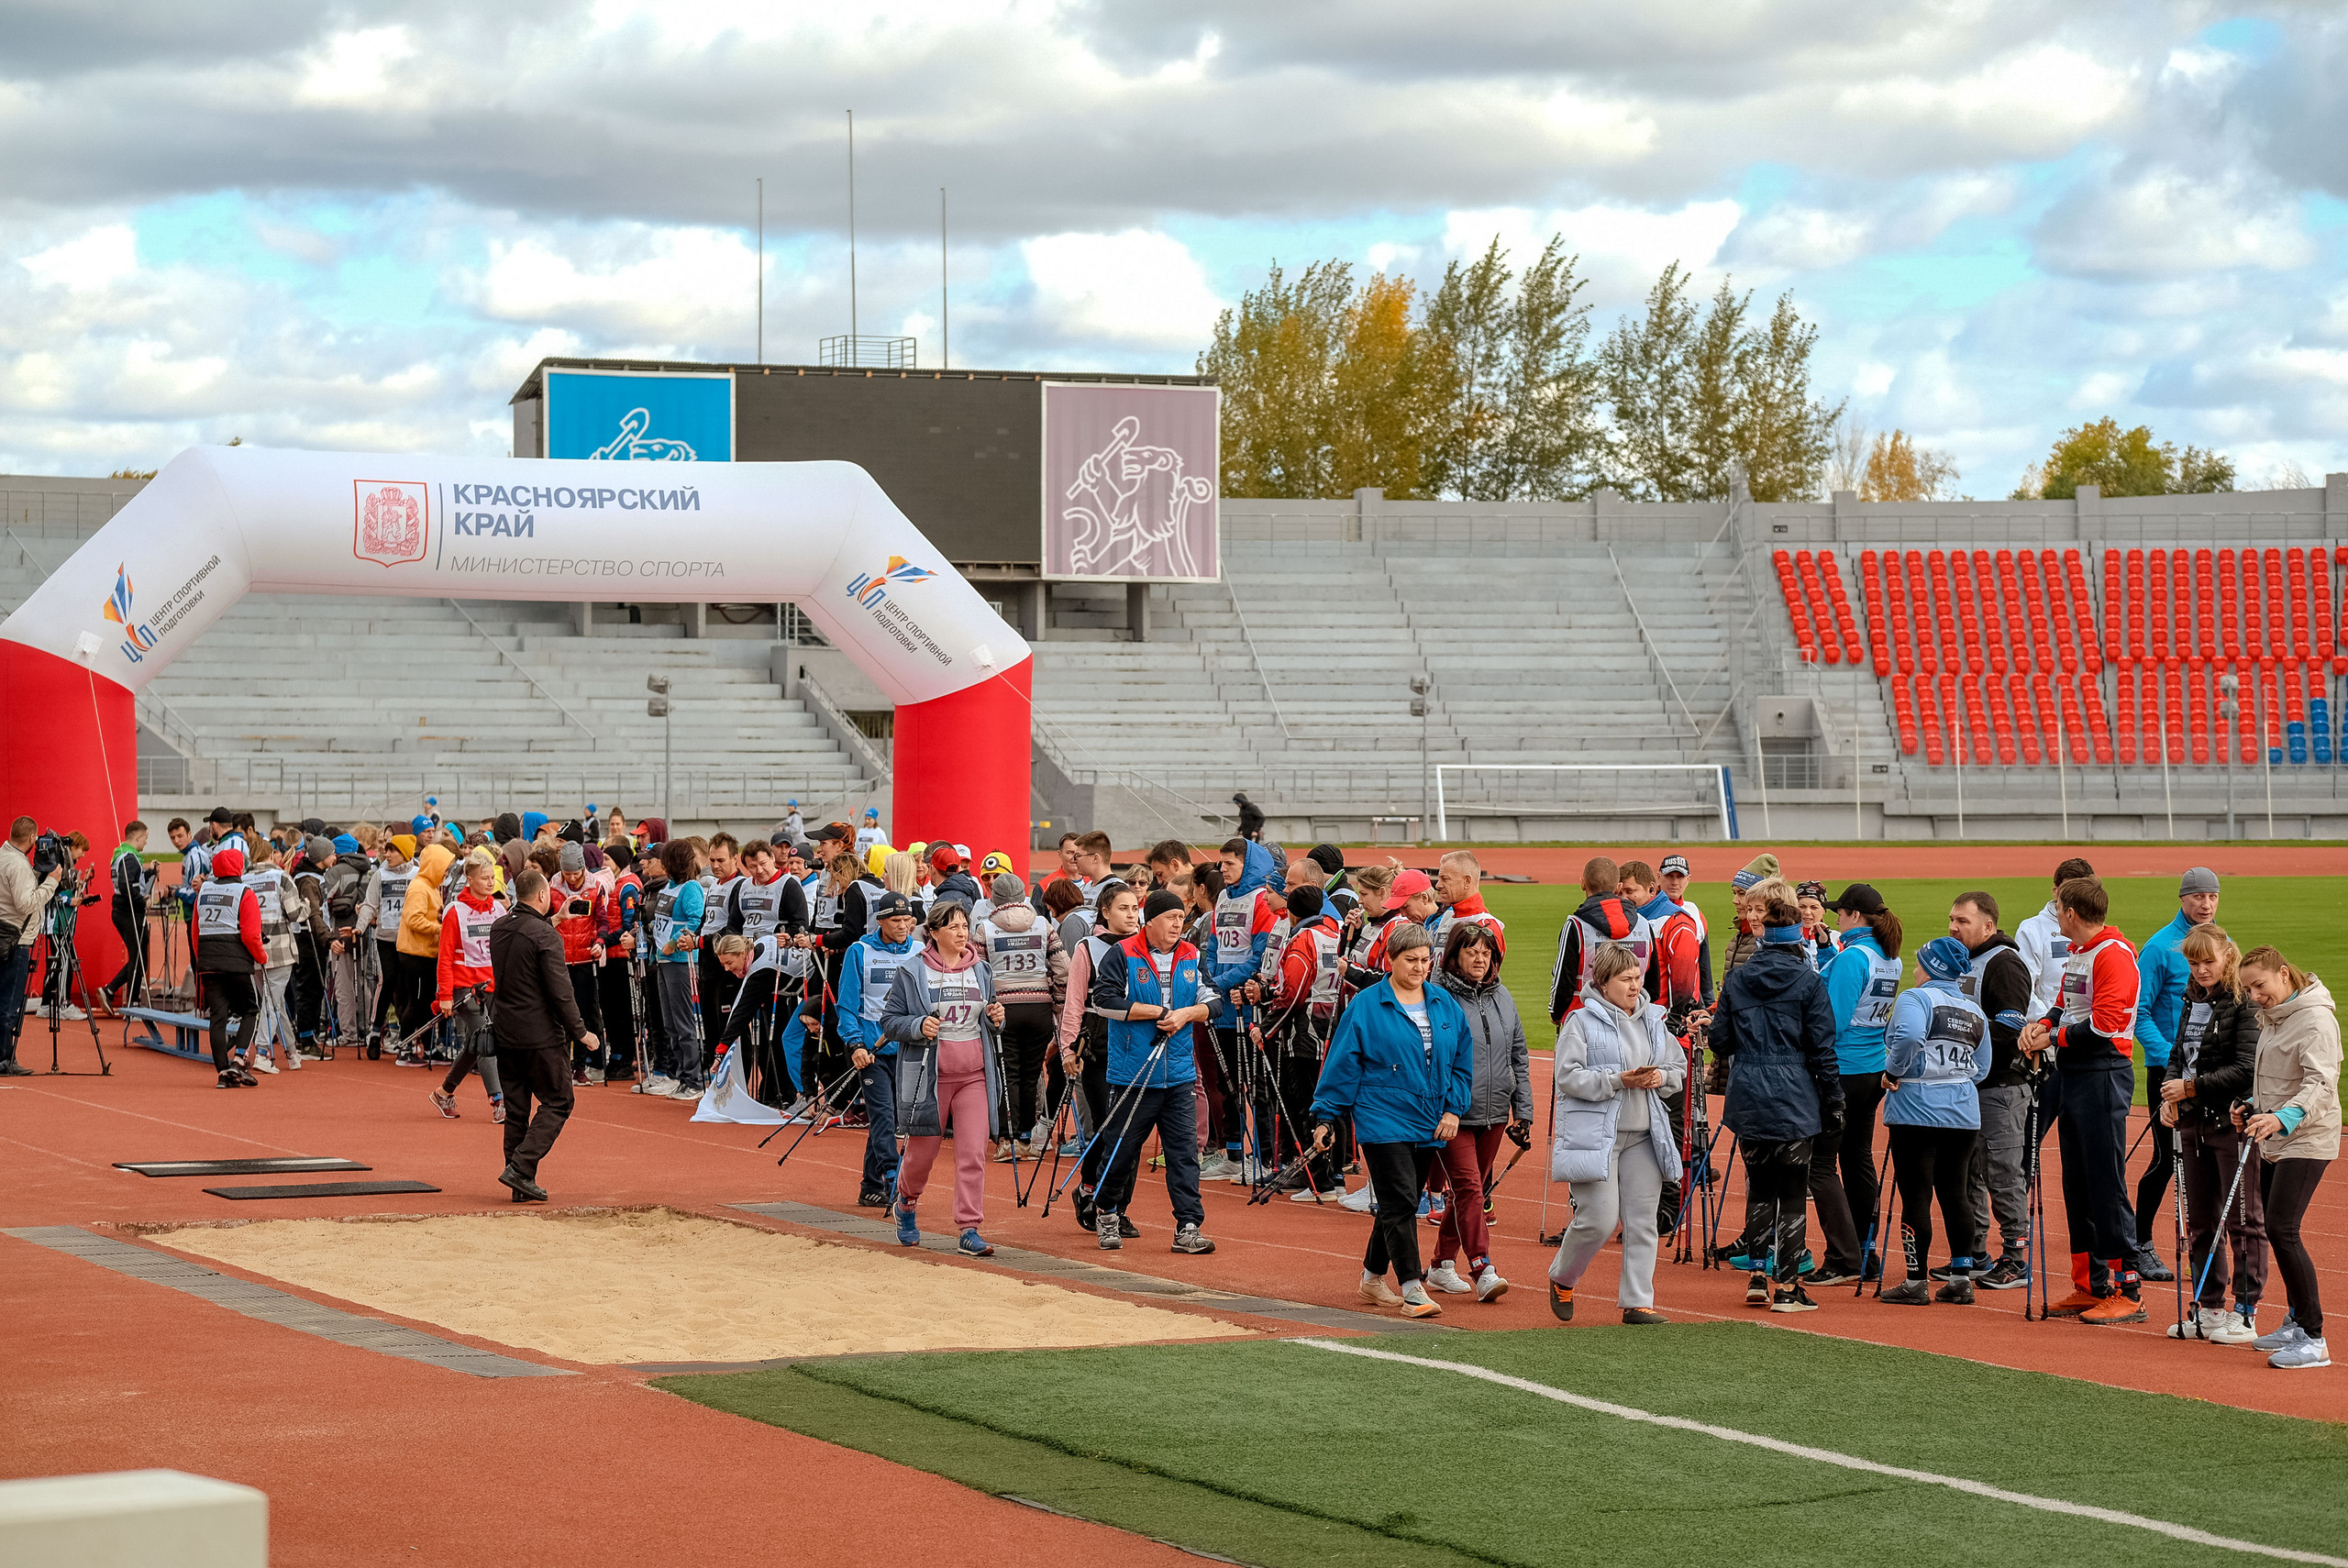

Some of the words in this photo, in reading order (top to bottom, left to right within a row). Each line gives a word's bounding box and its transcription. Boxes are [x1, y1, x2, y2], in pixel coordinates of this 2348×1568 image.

[453, 483, 701, 511] КРАСНОЯРСКИЙ
[454, 509, 534, 538] КРАЙ
[450, 556, 634, 576] МИНИСТЕРСТВО
[639, 560, 725, 578] СПОРТА
[150, 601, 172, 626] ЦЕНТР
[172, 554, 221, 604] СПОРТИВНОЙ
[158, 590, 205, 636] ПОДГОТОВКИ
[871, 609, 918, 654] ПОДГОТОВКИ
[883, 599, 909, 623] ЦЕНТР
[905, 621, 953, 667] СПОРТИВНОЙ
[1665, 856, 1687, 867] RUSSIA
[205, 908, 222, 922] 27
[386, 900, 404, 911] 14
[747, 912, 762, 925] 60
[1219, 930, 1239, 948] 103
[1002, 953, 1036, 971] 133
[945, 1005, 971, 1024] 47
[1947, 1017, 1973, 1028] СЕВЕРНАЯ
